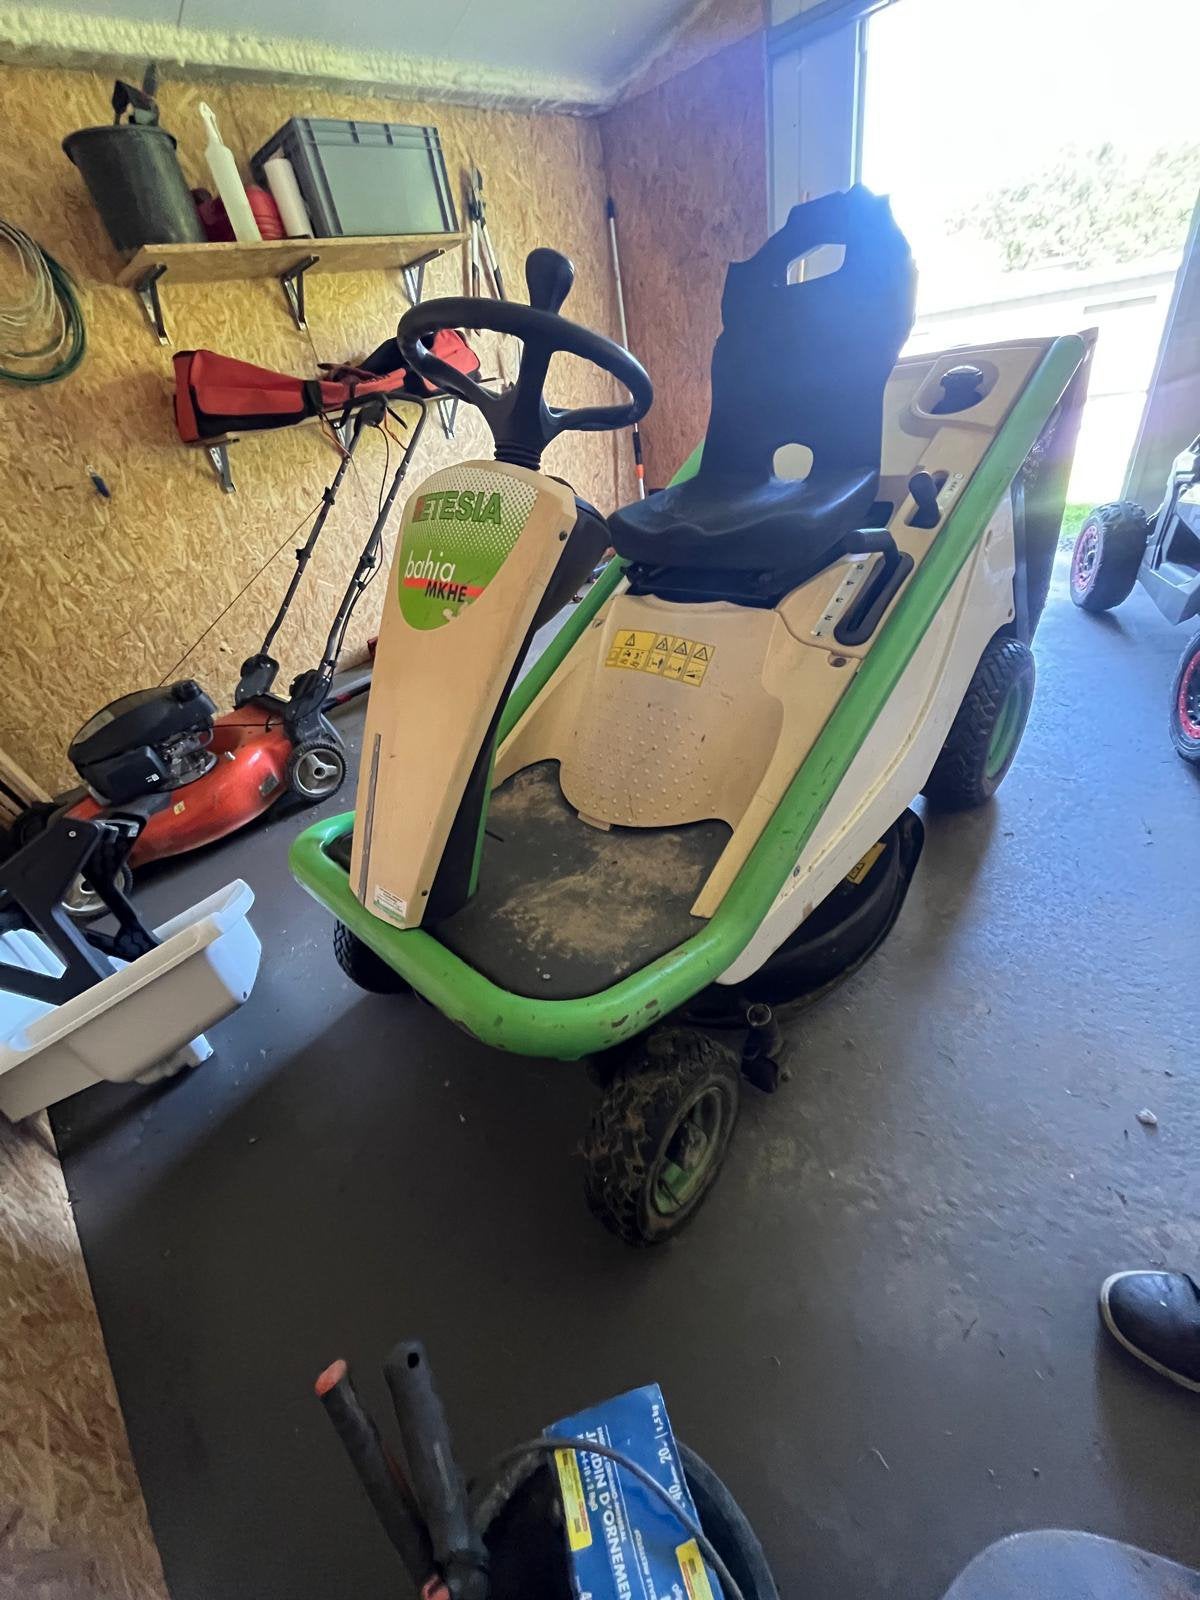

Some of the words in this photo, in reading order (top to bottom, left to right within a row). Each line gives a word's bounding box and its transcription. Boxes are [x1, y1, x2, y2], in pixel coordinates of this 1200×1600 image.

[412, 490, 501, 525] ETESIA
[404, 549, 456, 583] bahia
[424, 580, 468, 603] MKHE
[658, 1447, 673, 1464] 20
